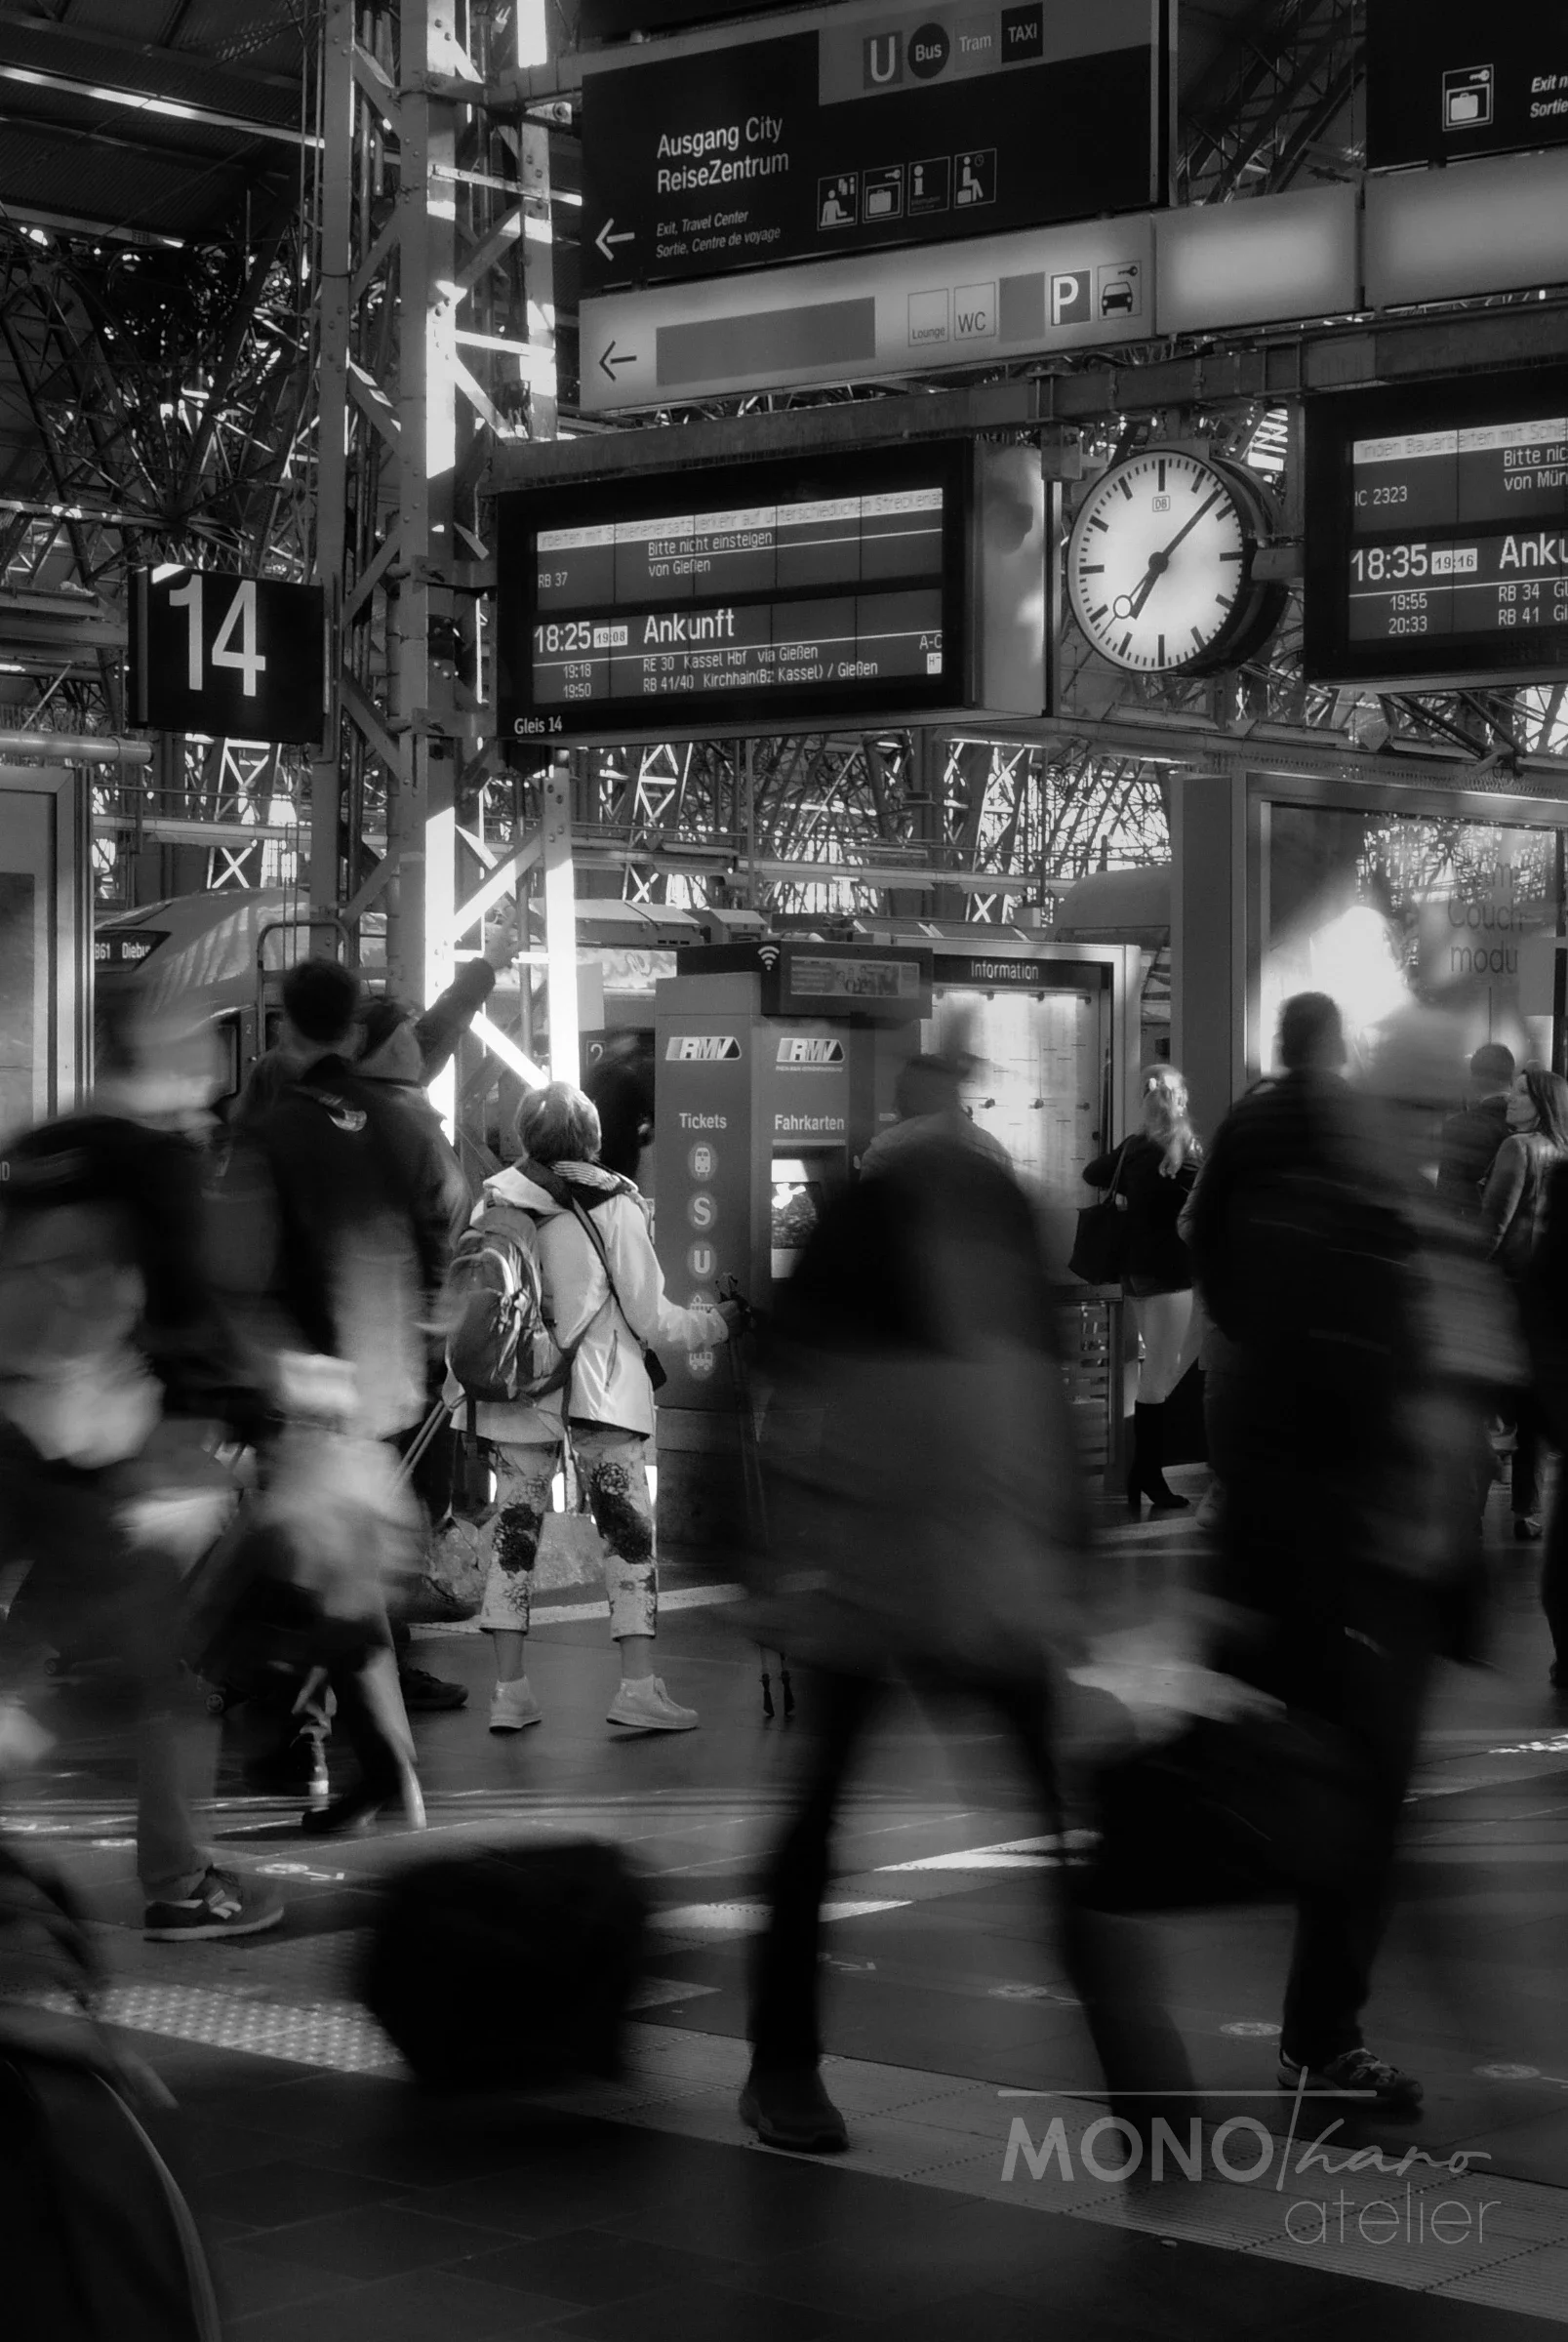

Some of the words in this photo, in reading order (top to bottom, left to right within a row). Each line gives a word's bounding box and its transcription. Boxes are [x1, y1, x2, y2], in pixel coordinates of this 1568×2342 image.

[870, 36, 896, 82] U
[915, 44, 943, 62] Bus
[959, 35, 991, 53] Tram
[1007, 22, 1038, 43] TAXI
[1531, 74, 1556, 93] Exit
[657, 126, 740, 159] Ausgang
[745, 116, 783, 143] City
[657, 152, 788, 193] ReiseZentrum
[682, 214, 712, 232] Travel
[714, 211, 748, 227] Center
[692, 235, 726, 253] Centre
[728, 232, 742, 246] de
[744, 226, 781, 244] voyage
[1054, 275, 1079, 324] P
[911, 326, 945, 340] Lounge
[957, 311, 986, 333] WC
[1504, 449, 1541, 466] Bitte
[1504, 475, 1532, 491] von
[1155, 499, 1167, 509] DB
[1354, 490, 1367, 506] IC
[1373, 485, 1408, 505] 2323
[648, 540, 676, 556] Bitte
[679, 536, 708, 554] nicht
[712, 531, 773, 550] einsteigen
[648, 563, 669, 577] von
[672, 558, 711, 575] Gießen
[1350, 544, 1427, 582] 18:35
[1435, 554, 1473, 570] 19:16
[538, 573, 551, 588] RB
[555, 572, 568, 586] 37
[1389, 592, 1427, 611] 19:55
[1499, 586, 1516, 602] RB
[1522, 583, 1540, 600] 34
[1388, 616, 1427, 634] 20:33
[1499, 608, 1516, 626] RB
[1522, 606, 1539, 624] 41
[169, 574, 266, 697] 14
[534, 622, 591, 653] 18:25
[596, 630, 625, 643] 19:08
[644, 608, 735, 644] Ankunft
[643, 657, 657, 672] RE
[661, 656, 674, 671] 30
[684, 652, 723, 669] Kassel
[727, 650, 746, 666] Hbf
[757, 648, 775, 663] via
[780, 645, 819, 662] Gießen
[643, 677, 657, 692] RB
[661, 674, 694, 692] 41/40
[837, 661, 878, 677] Gießen
[563, 683, 591, 699] 19:50
[514, 717, 545, 735] Gleis
[548, 714, 563, 732] 14
[971, 960, 1039, 980] Information
[673, 1035, 739, 1061] RMV
[782, 1037, 842, 1062] RMV
[678, 1112, 727, 1129] Tickets
[774, 1113, 845, 1131] Fahrkarten
[694, 1197, 711, 1226] S
[694, 1250, 711, 1273] U
